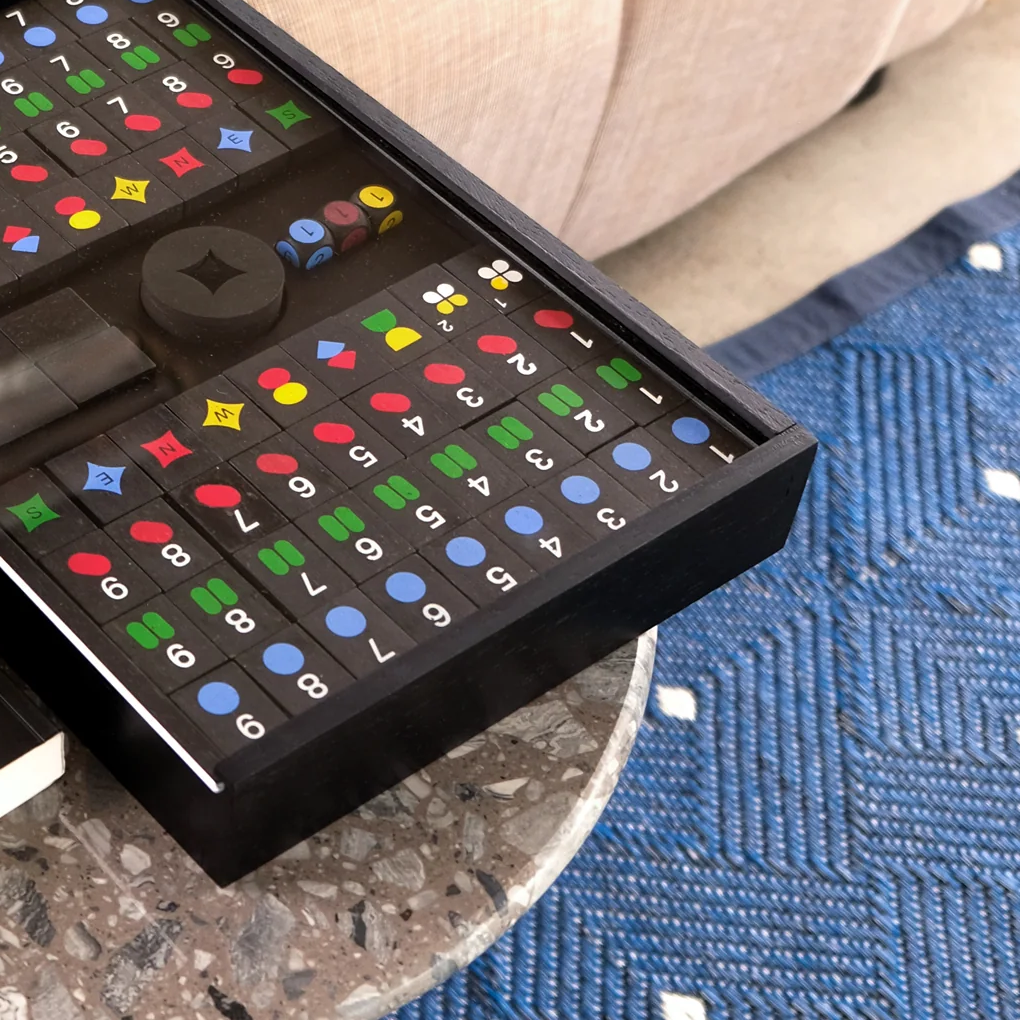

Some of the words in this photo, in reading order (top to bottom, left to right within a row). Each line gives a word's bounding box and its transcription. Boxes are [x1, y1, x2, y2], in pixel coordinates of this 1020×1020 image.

[5, 10, 26, 27] 7
[157, 12, 180, 28] 9
[106, 32, 131, 50] 8
[49, 54, 71, 72] 7
[212, 53, 235, 69] 9
[0, 78, 24, 95] 6
[161, 75, 188, 93] 8
[106, 95, 129, 115] 7
[55, 120, 81, 139] 6
[227, 133, 244, 145] E
[493, 297, 507, 309] 1
[436, 319, 454, 333] 2
[569, 331, 594, 349] 1
[506, 352, 538, 376] 2
[456, 386, 485, 408] 3
[639, 387, 663, 405] 1
[401, 415, 425, 437] 4
[573, 408, 606, 433] 2
[348, 445, 379, 469] 5
[524, 448, 554, 471] 3
[708, 445, 735, 464] 1
[95, 471, 114, 486] E
[288, 476, 316, 499] 6
[466, 475, 491, 497] 4
[648, 469, 680, 493] 2
[233, 508, 260, 534] 7
[415, 504, 447, 530] 5
[596, 507, 627, 531] 3
[160, 543, 192, 568] 8
[354, 537, 384, 561] 6
[537, 535, 563, 559] 4
[100, 576, 129, 600] 9
[300, 571, 328, 597] 7
[485, 566, 518, 592] 5
[224, 608, 256, 634] 8
[422, 602, 452, 628] 6
[166, 643, 196, 669] 9
[368, 637, 397, 664] 7
[296, 672, 329, 700] 8
[235, 713, 266, 740] 9
